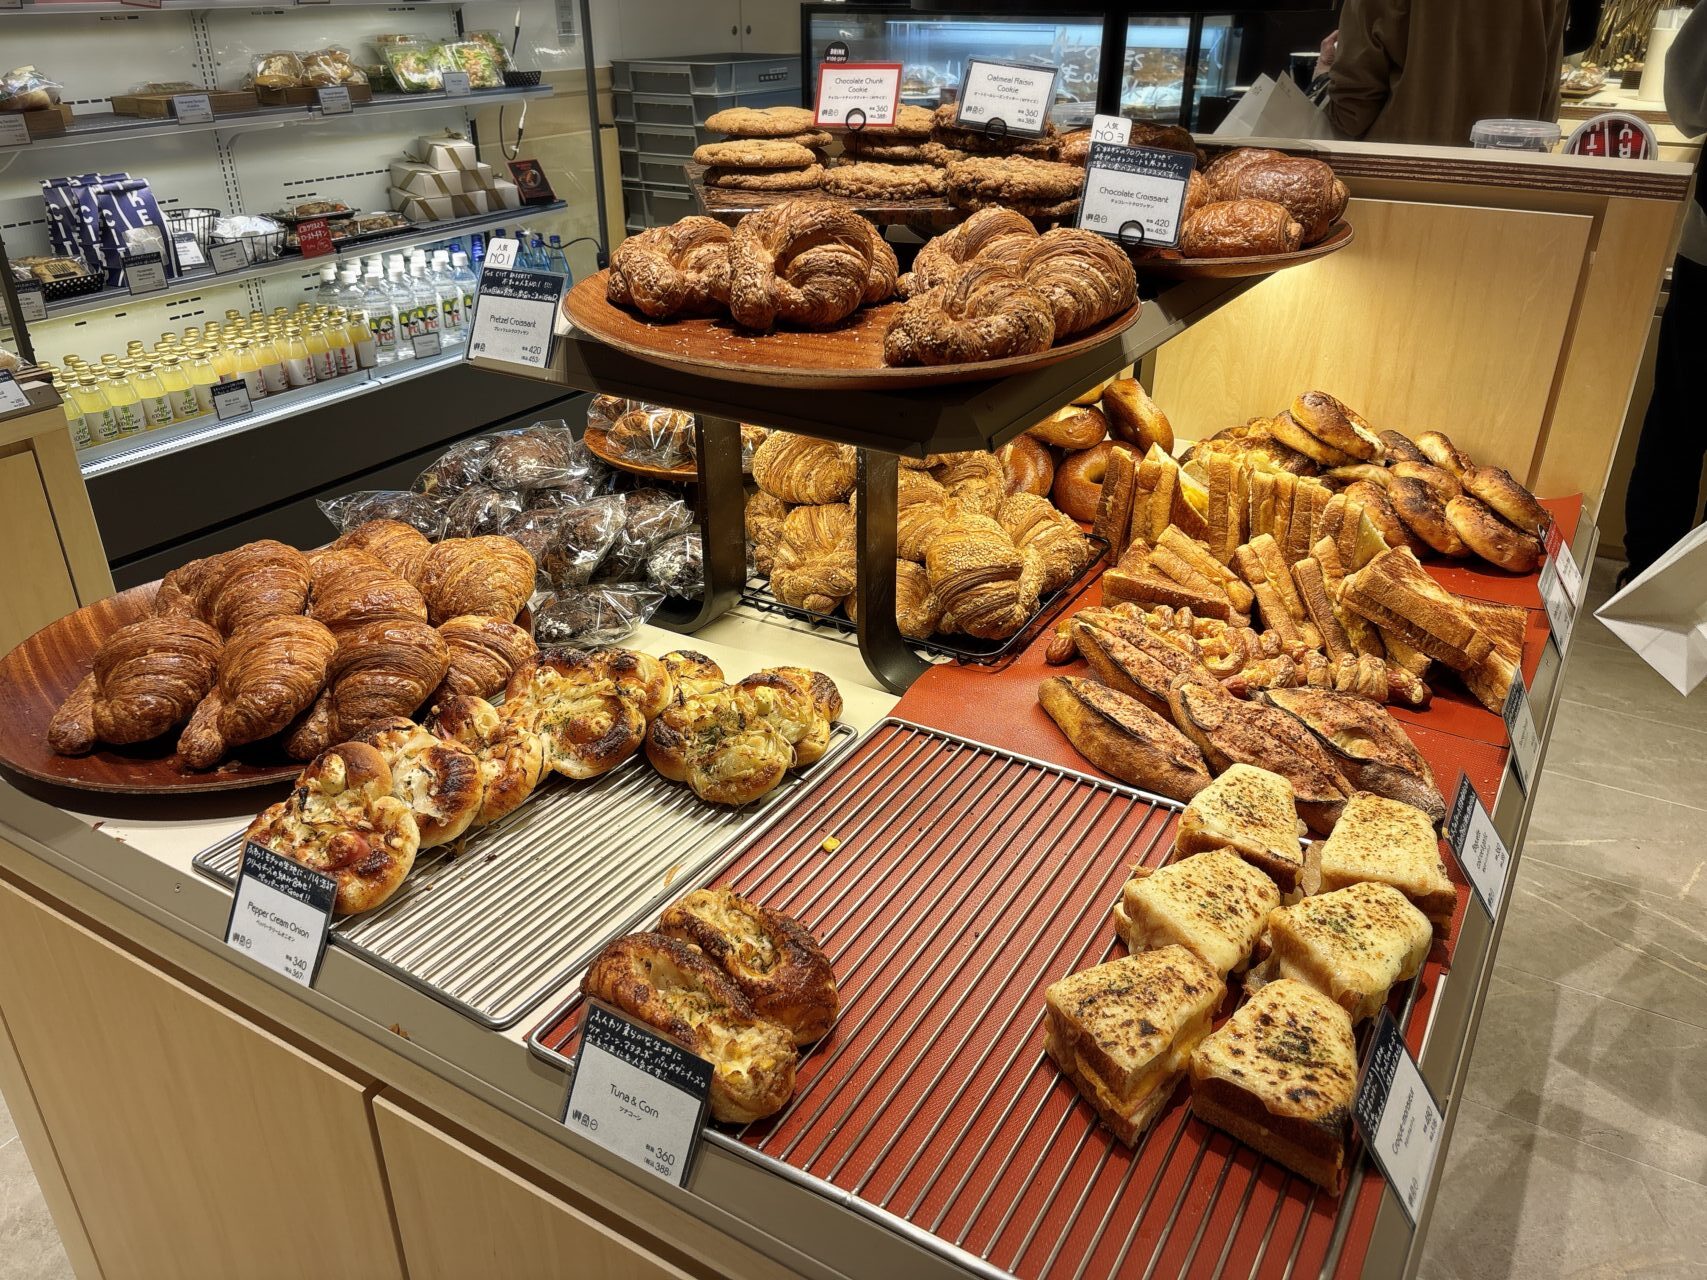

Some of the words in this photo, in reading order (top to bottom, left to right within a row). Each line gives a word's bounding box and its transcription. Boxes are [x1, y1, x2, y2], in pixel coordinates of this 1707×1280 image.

[834, 77, 864, 86] Chocolate
[864, 77, 883, 86] Chunk
[986, 74, 1014, 84] Oatmeal
[1015, 76, 1034, 86] Raisin
[848, 86, 868, 94] Cookie
[997, 84, 1019, 94] Cookie
[875, 104, 888, 112] 360
[1025, 108, 1038, 118] 360
[1105, 122, 1119, 130] 人気
[1100, 186, 1134, 199] Chocolate
[1136, 192, 1168, 204] Croissant
[1154, 218, 1170, 228] 420
[490, 314, 509, 325] Pretzel
[510, 318, 536, 328] Croissant
[528, 346, 542, 354] 420
[248, 902, 269, 919] Pepper
[269, 912, 289, 928] Cream
[290, 922, 310, 939] Onion
[292, 956, 307, 970] 340
[610, 1083, 630, 1102] Tuna
[630, 1096, 638, 1107] &
[639, 1100, 659, 1118] Corn
[619, 1105, 642, 1122] ツナコーン
[655, 1148, 676, 1166] 360
